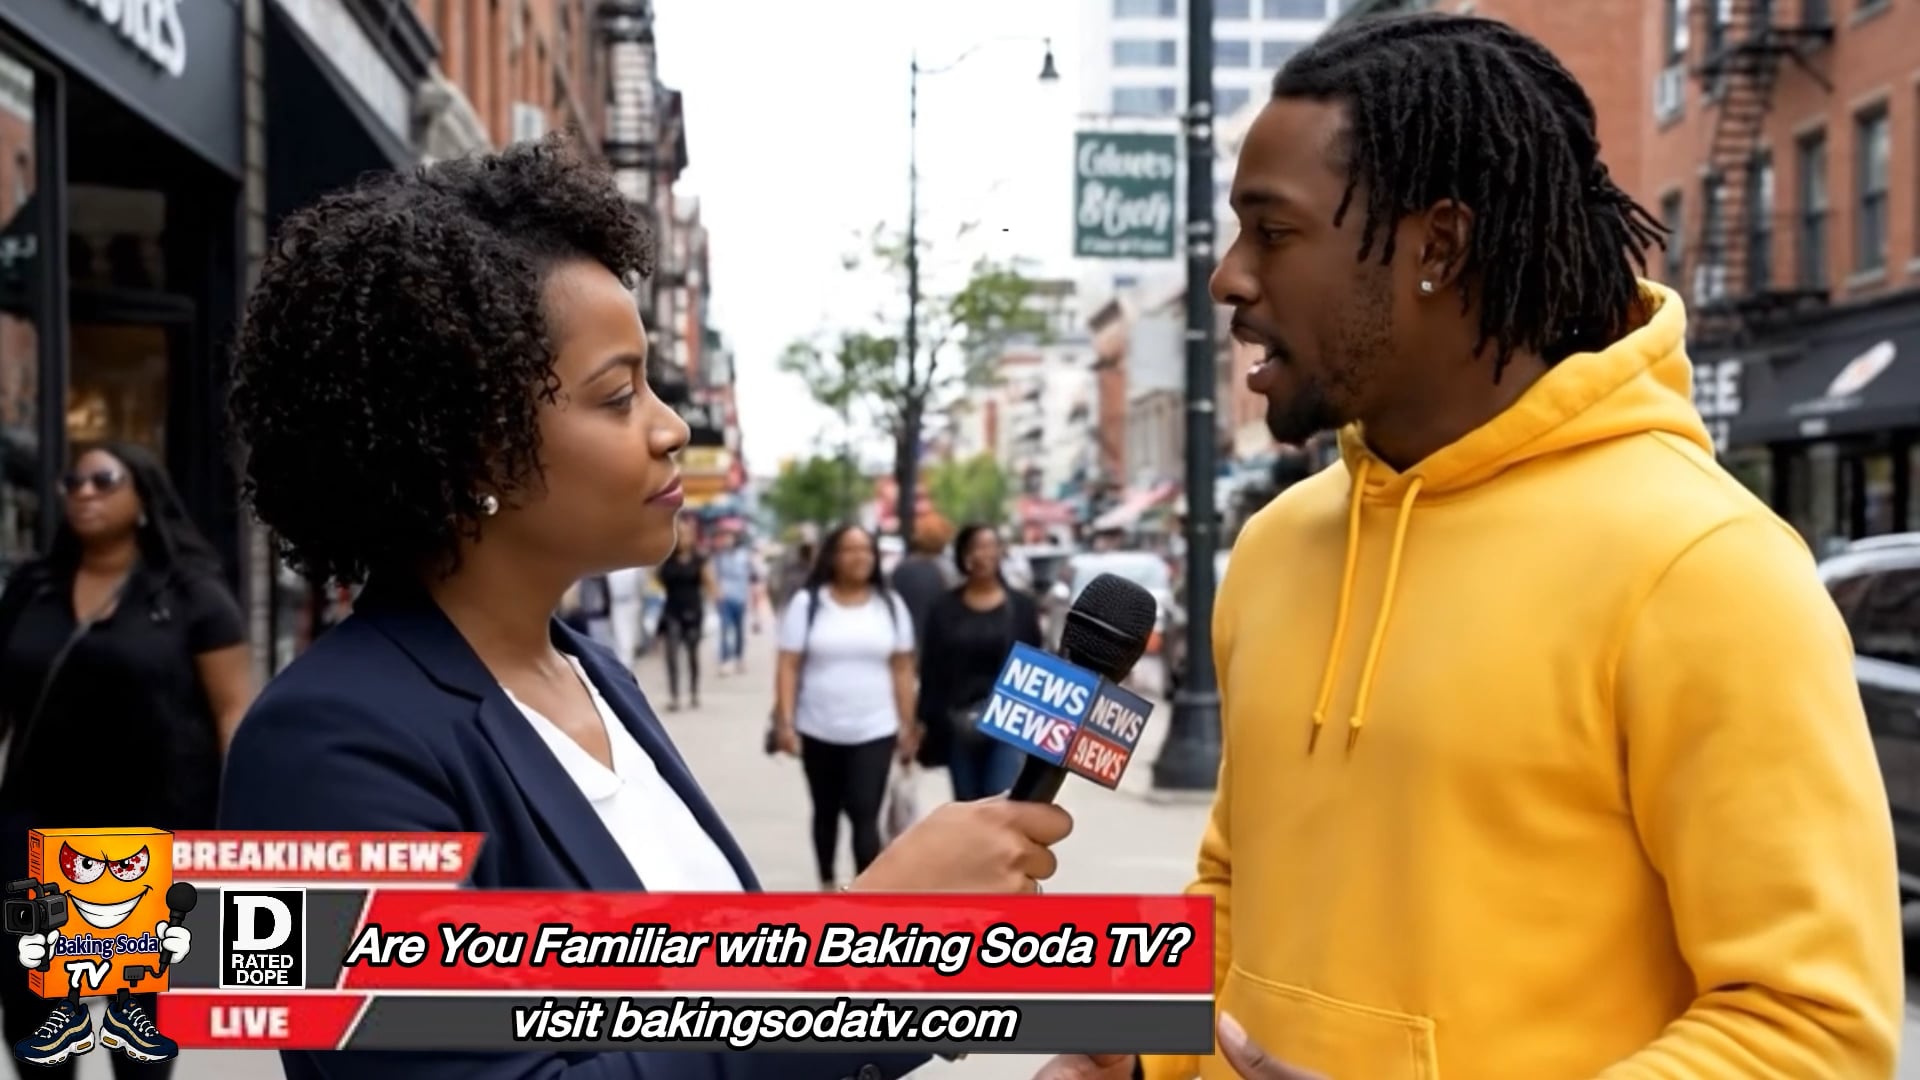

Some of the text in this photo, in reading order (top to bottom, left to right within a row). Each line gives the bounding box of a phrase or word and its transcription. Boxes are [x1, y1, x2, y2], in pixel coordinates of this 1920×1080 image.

[1003, 658, 1089, 716] NEWS
[983, 693, 1069, 753] NEWS
[1090, 695, 1143, 744] NEWS
